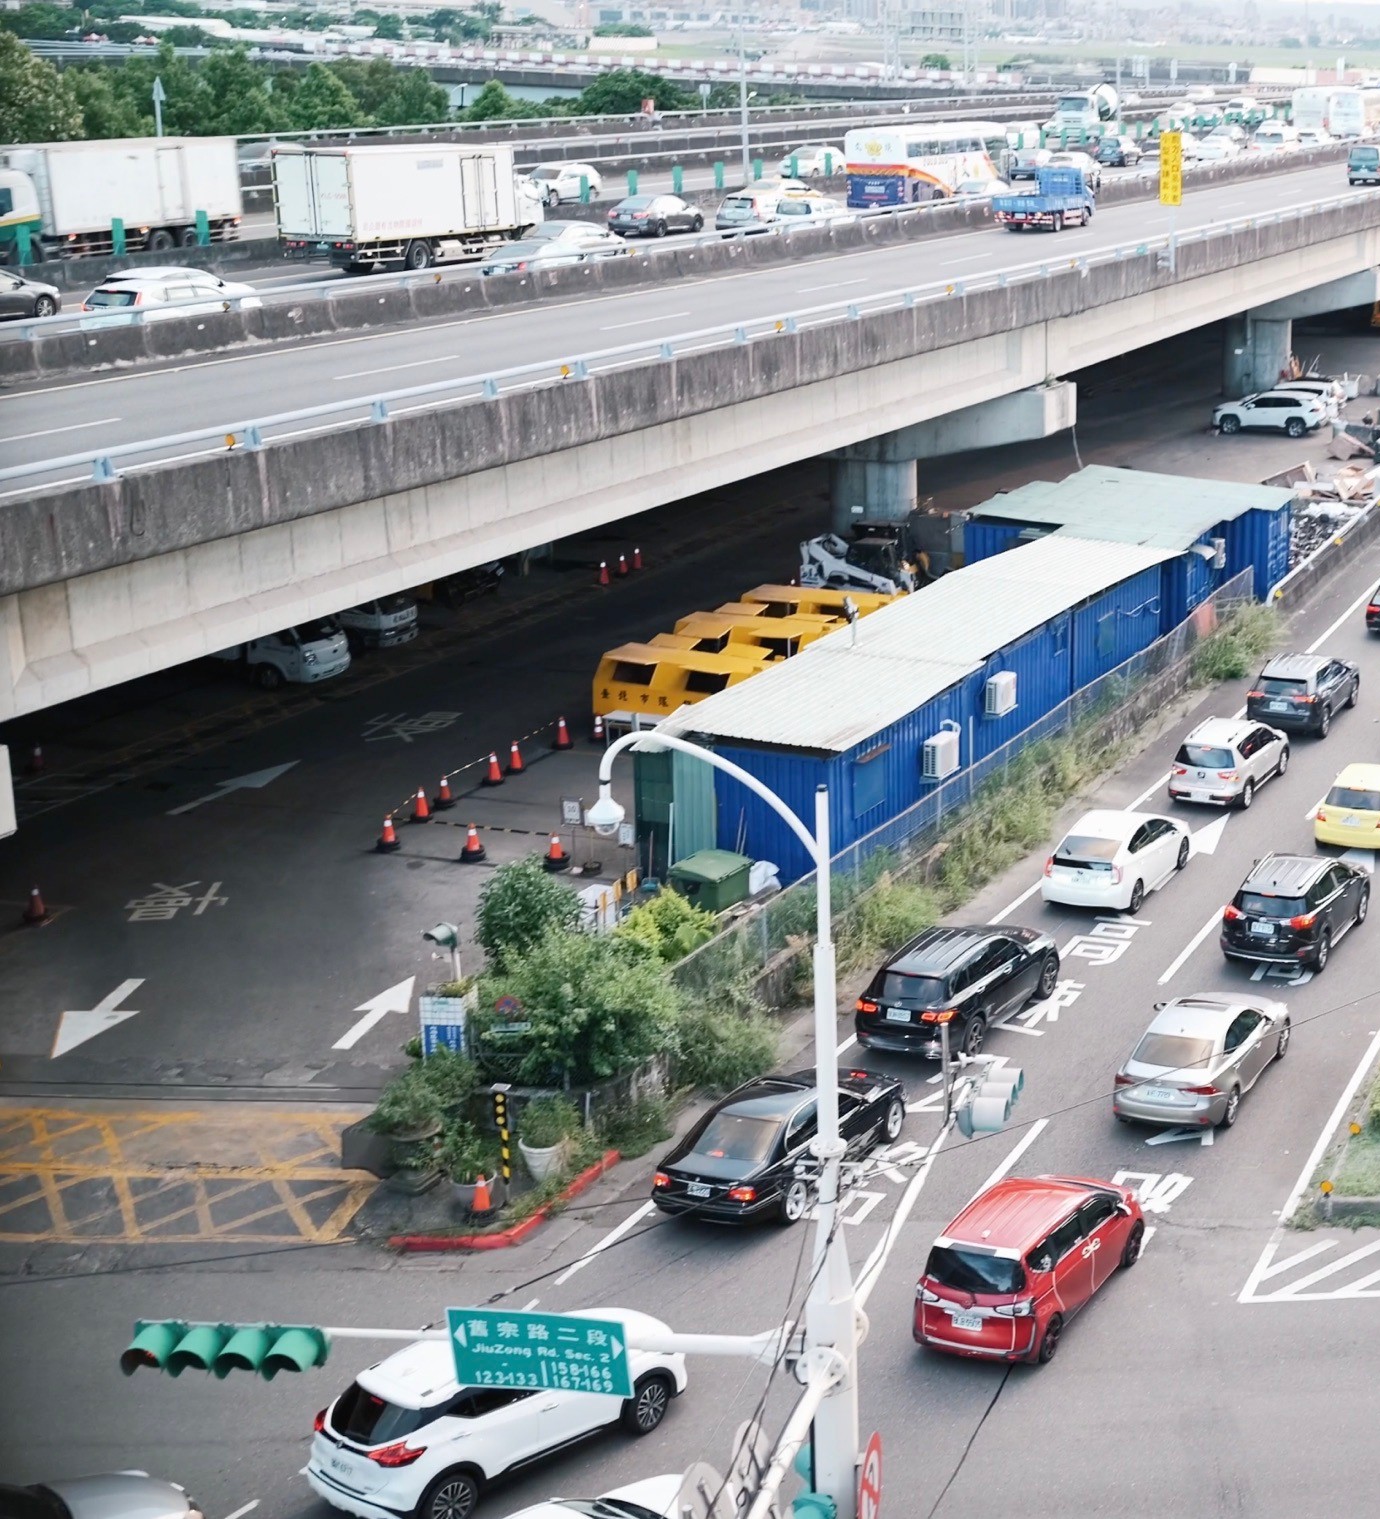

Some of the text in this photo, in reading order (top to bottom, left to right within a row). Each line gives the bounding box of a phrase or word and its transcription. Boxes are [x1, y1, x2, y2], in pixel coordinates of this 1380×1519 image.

[600, 688, 692, 708] 臺北市環
[467, 1319, 609, 1347] 舊宗路二段
[471, 1343, 611, 1363] JiuZong Rd. Sec. 2
[474, 1370, 538, 1386] 123-133
[550, 1361, 613, 1379] 158-166
[552, 1375, 614, 1392] 167-169
